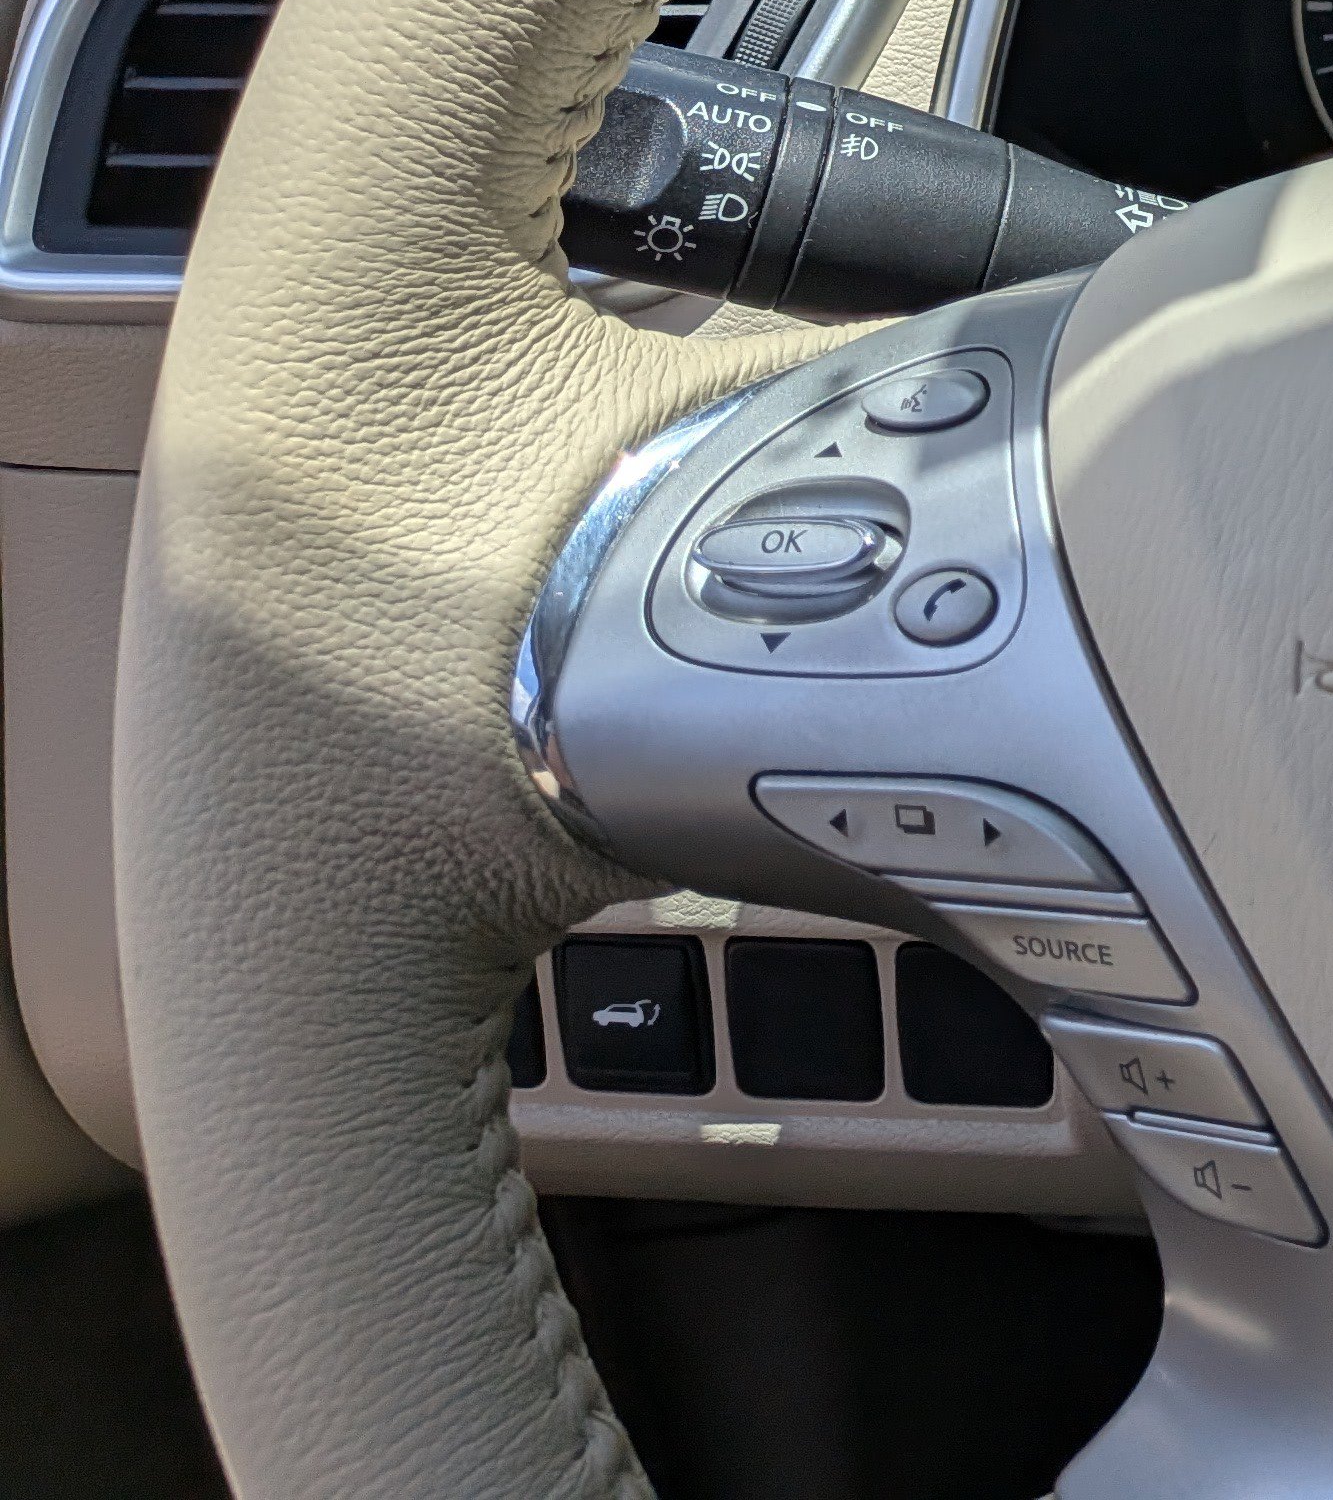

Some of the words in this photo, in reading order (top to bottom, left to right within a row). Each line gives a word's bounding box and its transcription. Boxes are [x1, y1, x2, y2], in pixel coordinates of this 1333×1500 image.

[716, 82, 777, 103] OFF
[687, 101, 773, 134] AUTO
[845, 112, 903, 133] OFF
[761, 530, 807, 555] OK
[1013, 933, 1114, 967] SOURCE
